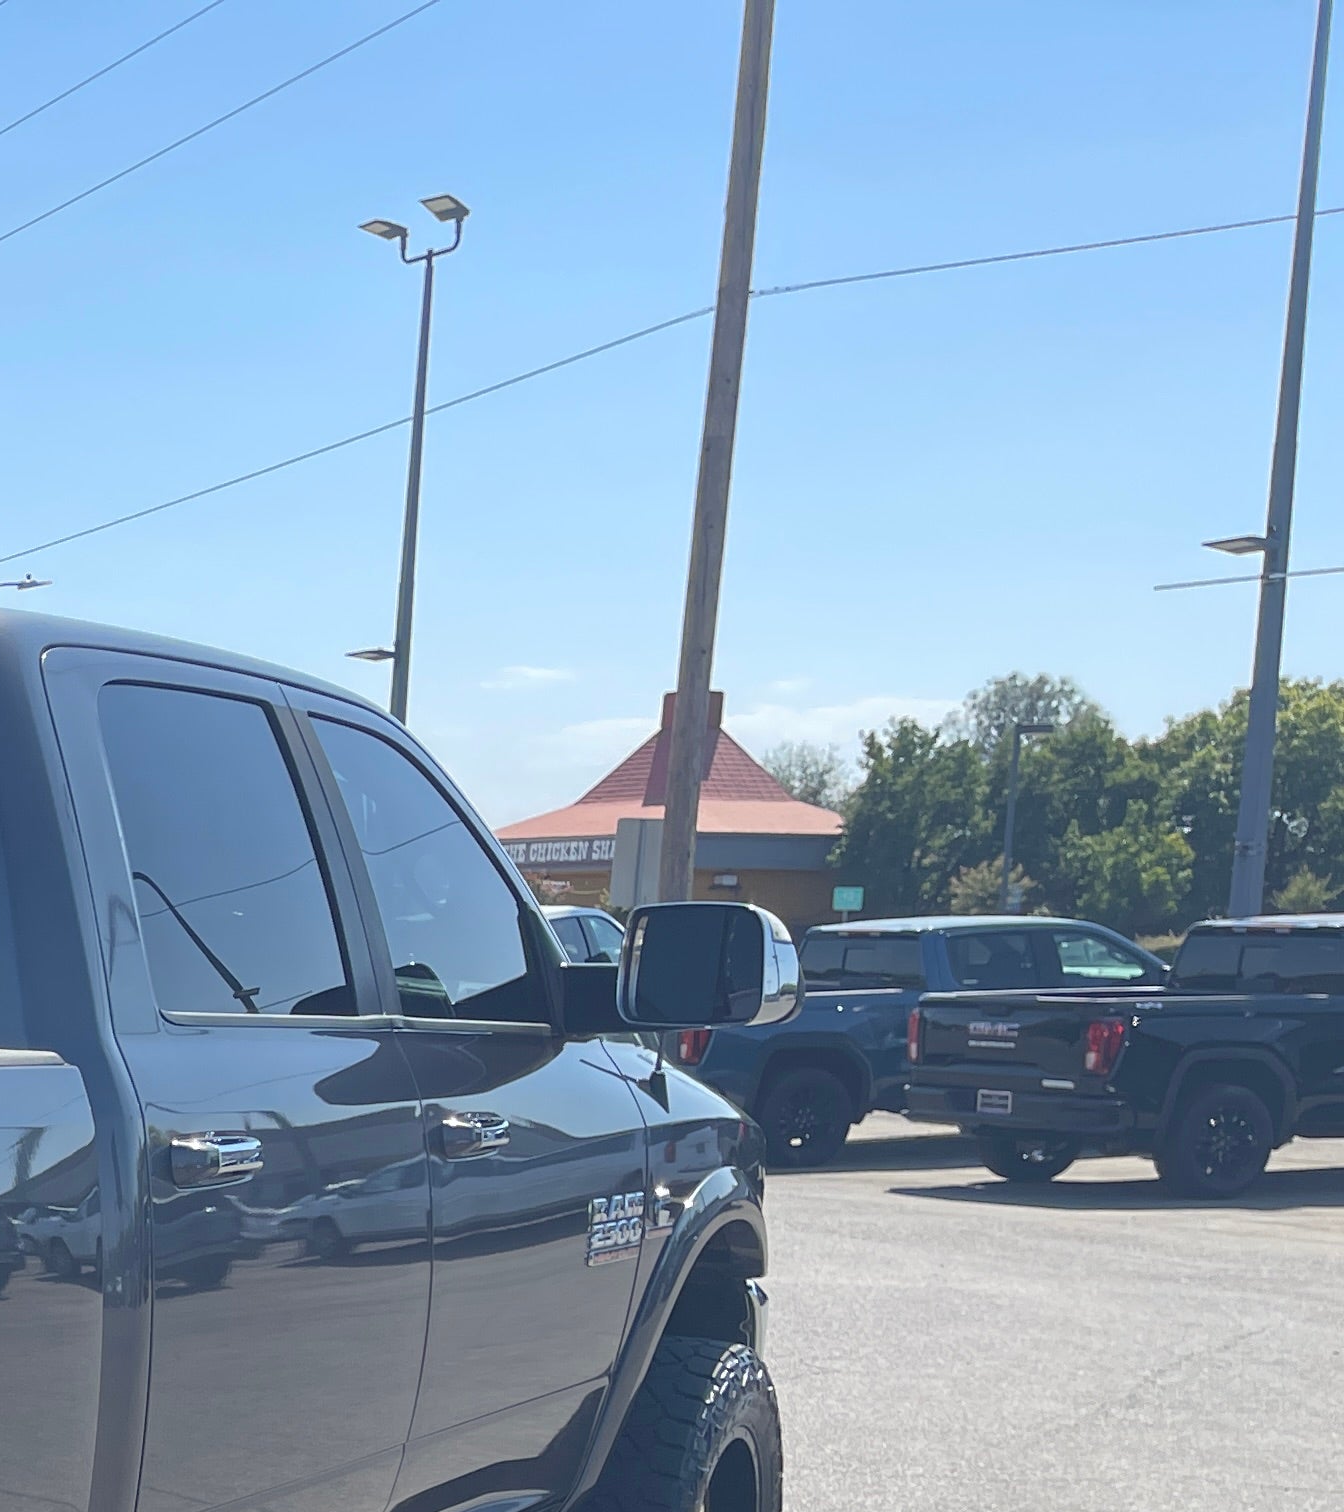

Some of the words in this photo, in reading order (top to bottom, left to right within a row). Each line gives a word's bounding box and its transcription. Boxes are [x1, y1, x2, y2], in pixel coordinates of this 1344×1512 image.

[529, 840, 589, 862] CHICKEN
[590, 1191, 645, 1224] RAM
[590, 1217, 642, 1250] 2500
